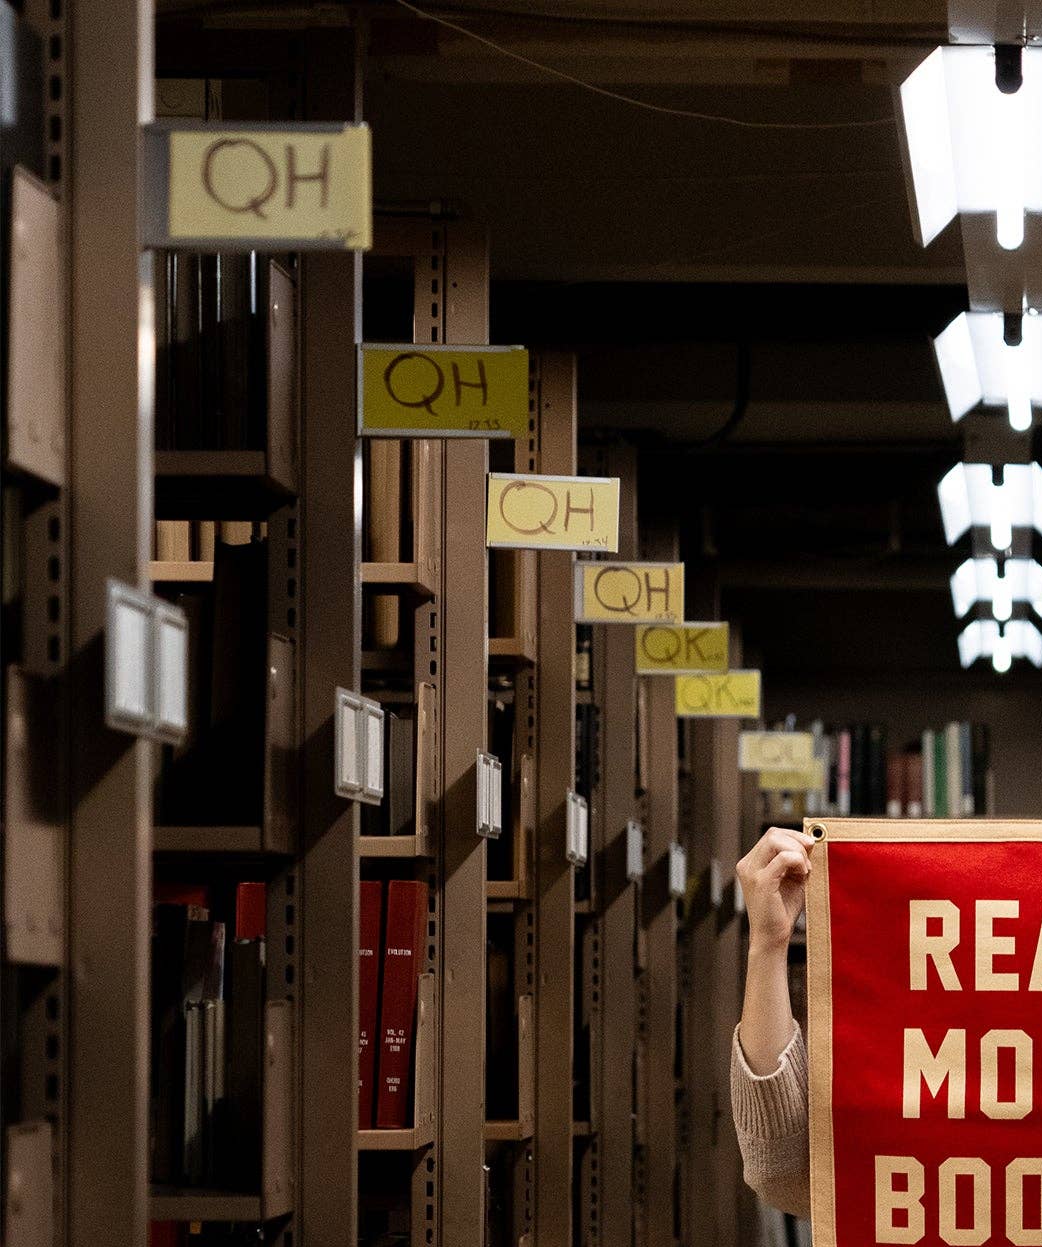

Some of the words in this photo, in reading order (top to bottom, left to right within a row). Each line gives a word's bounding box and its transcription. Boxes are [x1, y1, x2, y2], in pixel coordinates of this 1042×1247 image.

[202, 137, 331, 219] QH
[384, 352, 488, 417] QH
[499, 480, 595, 535] QH
[594, 566, 670, 614] QH
[641, 626, 709, 663] QK
